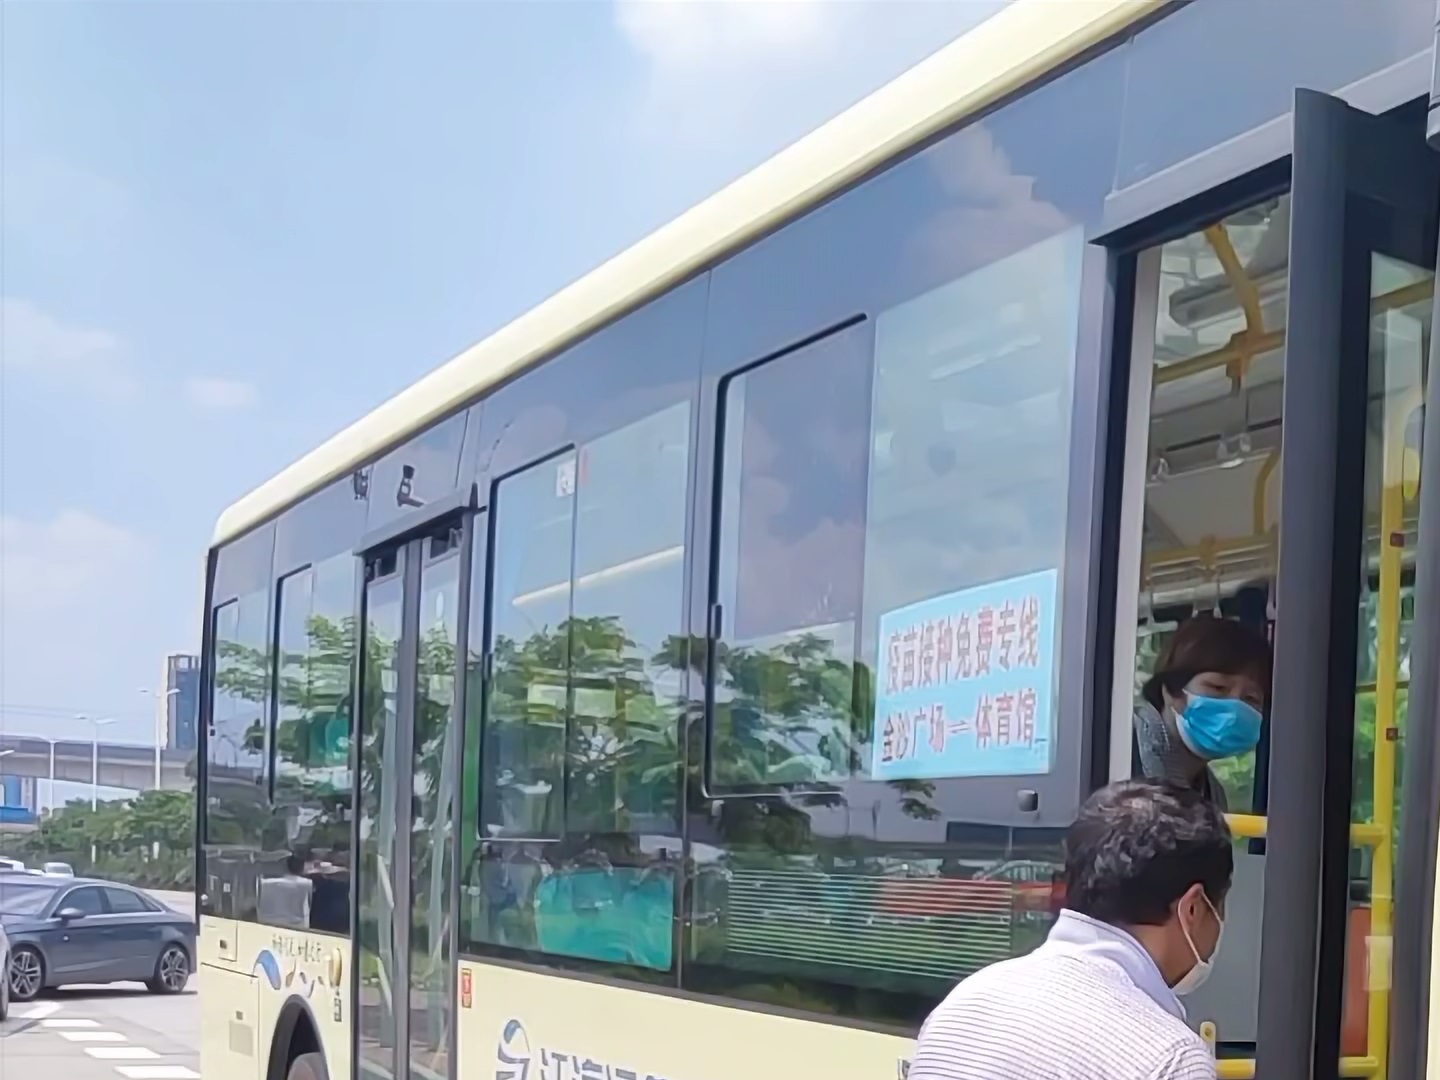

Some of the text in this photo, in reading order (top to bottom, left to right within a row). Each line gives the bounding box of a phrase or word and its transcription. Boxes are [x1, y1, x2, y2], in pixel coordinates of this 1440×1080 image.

[886, 593, 1040, 695] 疫苗接种免费专线
[881, 687, 1037, 762] 金沙广场 体育馆
